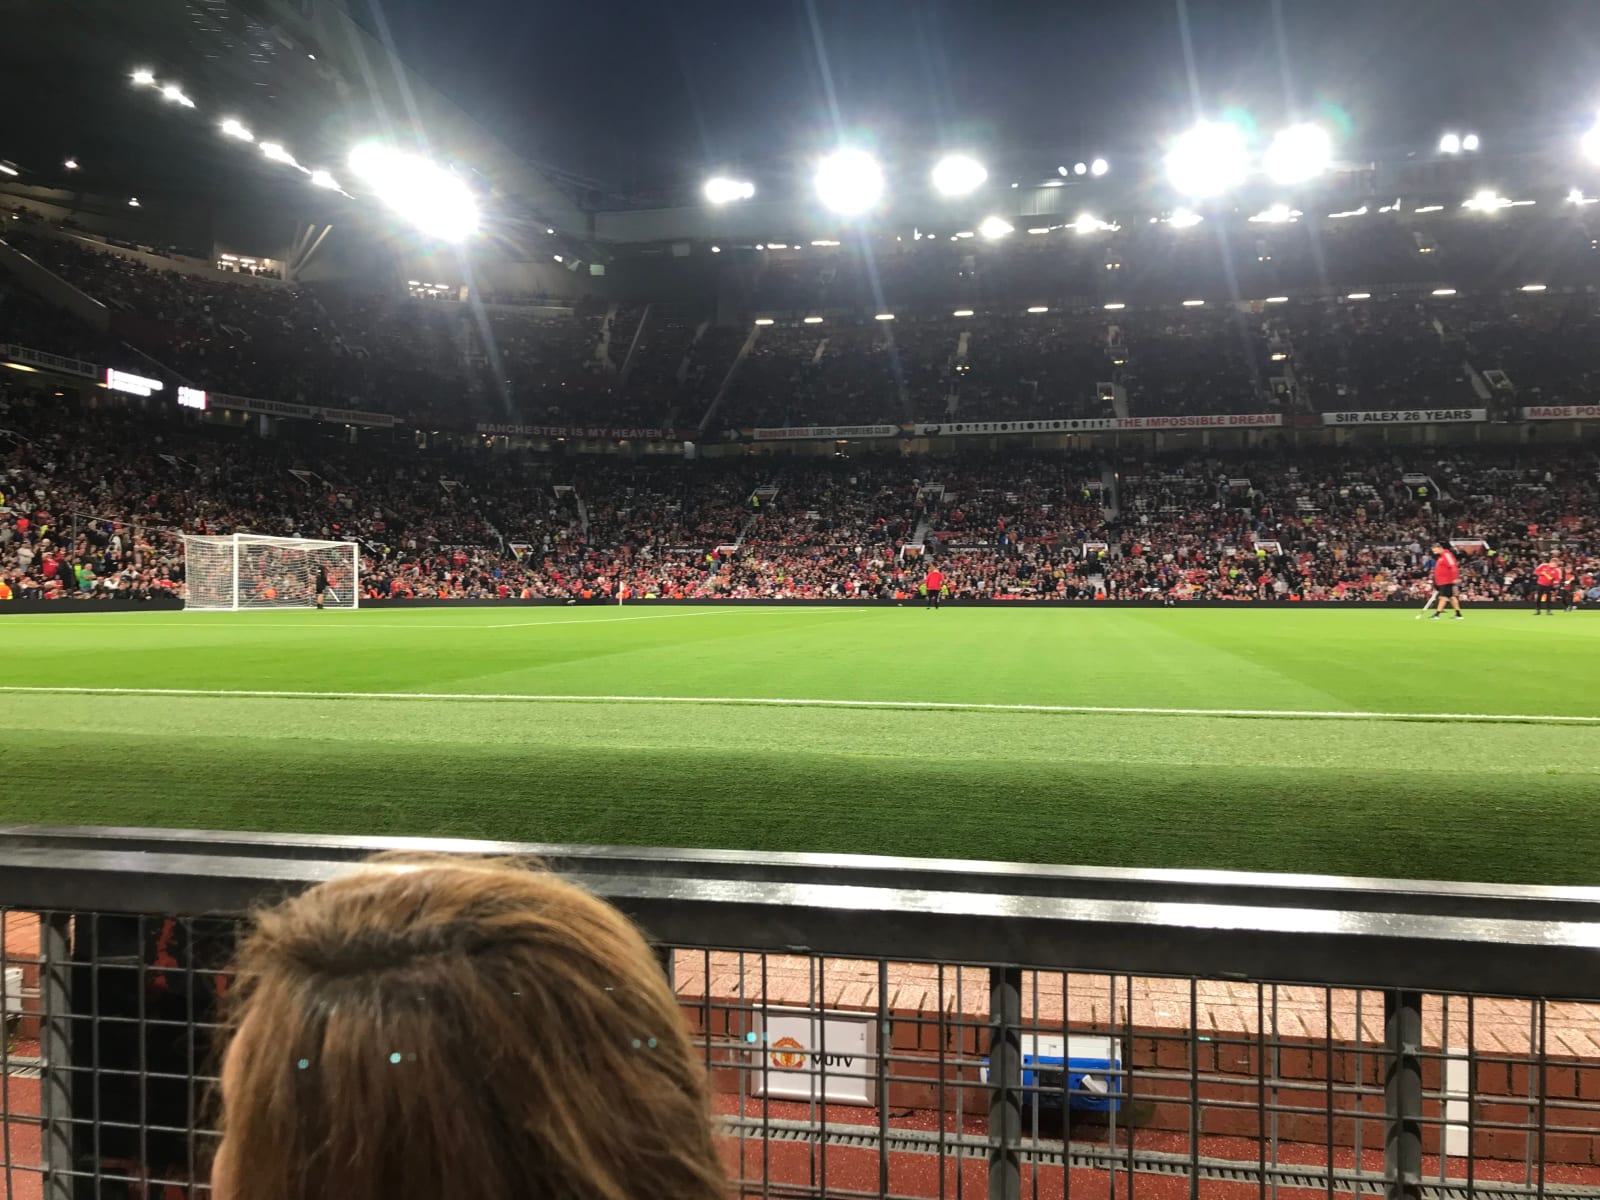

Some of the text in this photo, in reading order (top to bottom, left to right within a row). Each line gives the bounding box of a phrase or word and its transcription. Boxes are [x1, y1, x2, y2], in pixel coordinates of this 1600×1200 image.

[1335, 410, 1473, 422] SIR ALEX 26 YEARS
[1529, 407, 1571, 417] MADE
[1116, 414, 1277, 428] THE IMPOSSIBLE DREAM
[476, 423, 663, 439] MANCHESTER IS MY HEAVEN
[811, 1053, 854, 1068] MUTV
